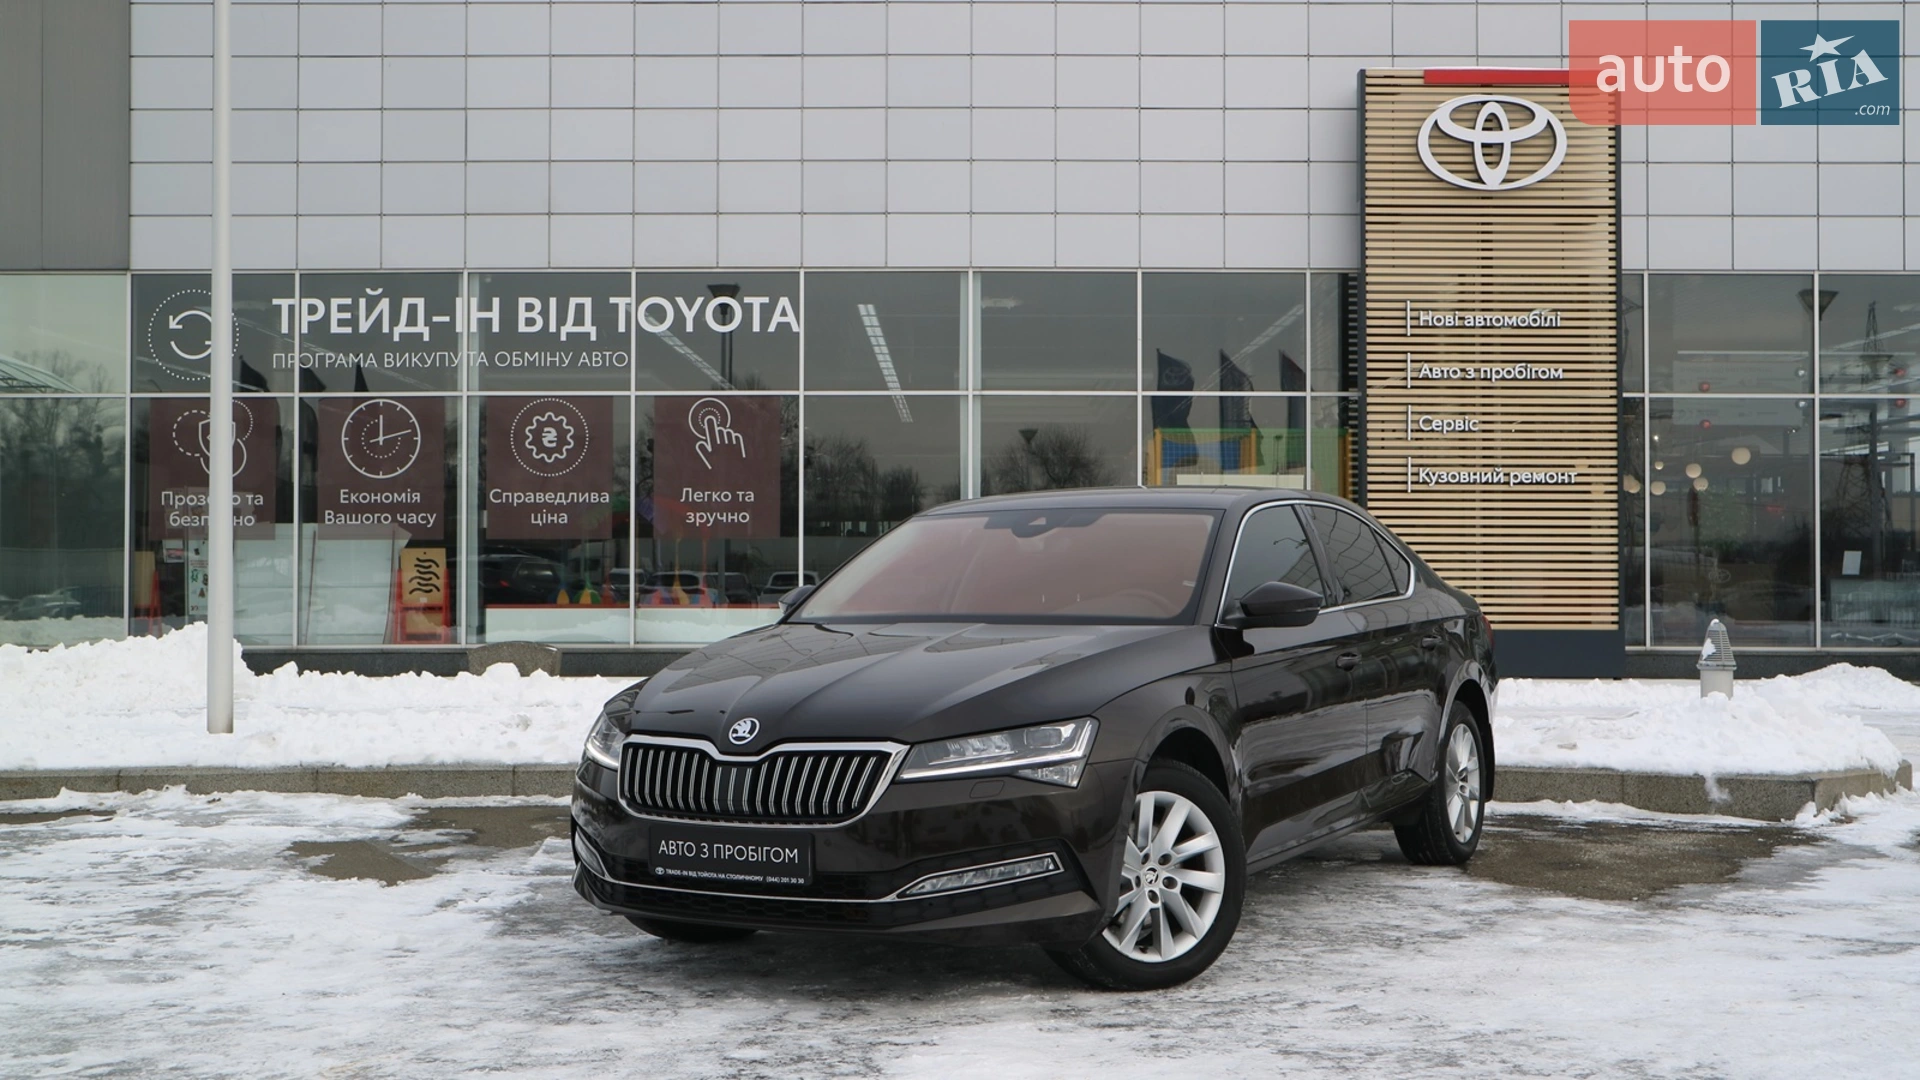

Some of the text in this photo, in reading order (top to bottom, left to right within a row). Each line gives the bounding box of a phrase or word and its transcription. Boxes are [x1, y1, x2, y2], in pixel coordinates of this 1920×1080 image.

[272, 288, 800, 341] ТРЕЙД-ІН ВІД TOYOTA
[1418, 310, 1561, 327] Нові автомобілі
[273, 351, 629, 369] ПРОГРАМА ВИКУПУ ТА ОБМІНУ АВТО
[1418, 363, 1563, 382] Авто з пробігом
[1418, 415, 1479, 434] Сервіс
[1418, 468, 1577, 488] Кузовний ремонт
[161, 491, 264, 509] Прозо та
[340, 489, 421, 504] Економія
[489, 489, 610, 506] Справедлива
[680, 488, 755, 503] Легко та
[169, 511, 255, 526] безпно
[325, 510, 437, 527] Вашого часу
[531, 510, 568, 526] ціна
[685, 511, 750, 527] зручно
[658, 840, 798, 864] АВТО З ПРОБІГОМ
[666, 868, 688, 876] TRADE-IN
